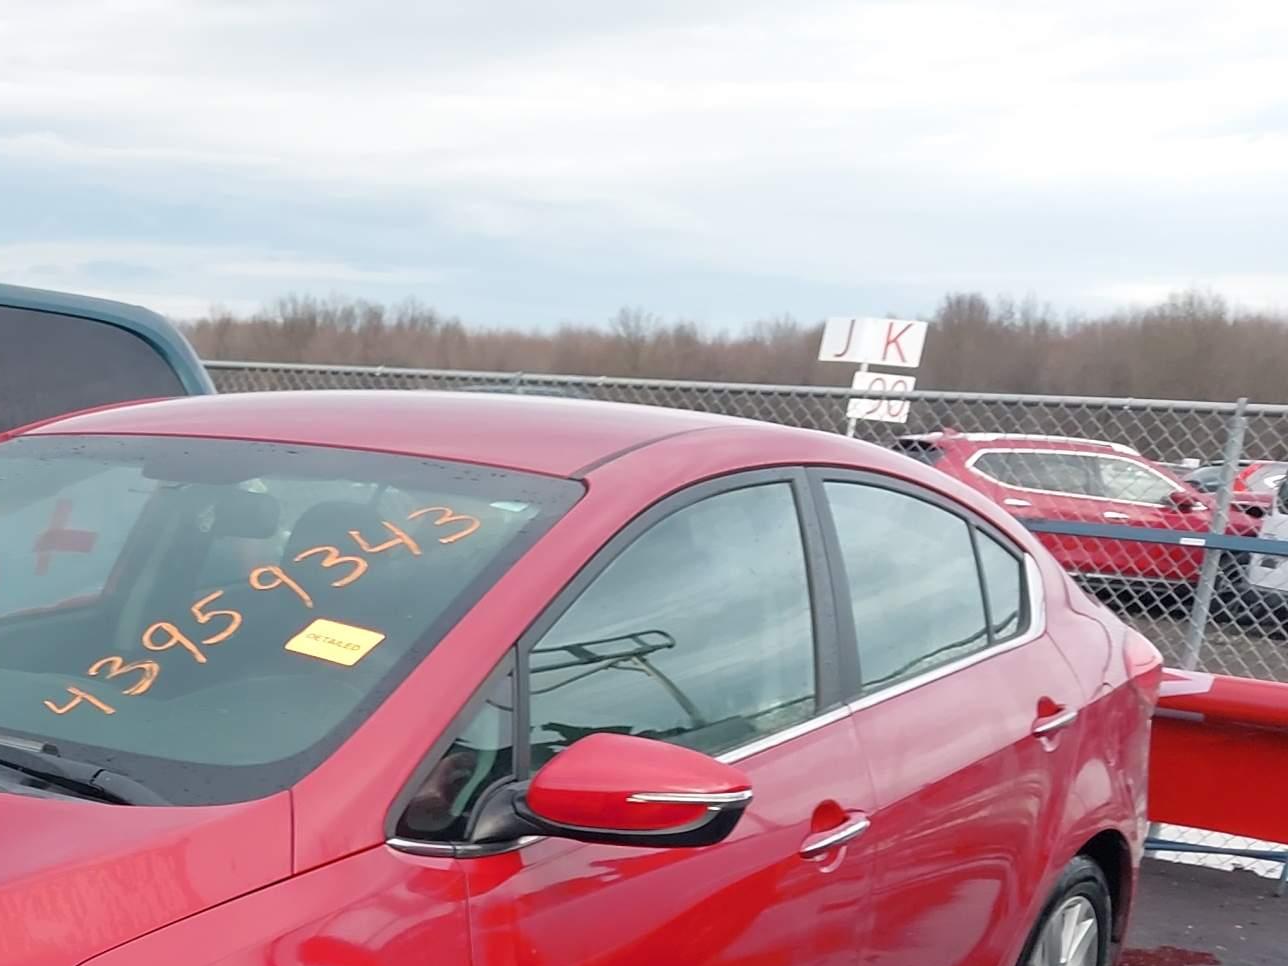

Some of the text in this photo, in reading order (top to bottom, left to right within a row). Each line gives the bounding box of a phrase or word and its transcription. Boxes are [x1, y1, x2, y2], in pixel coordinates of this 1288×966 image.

[833, 319, 915, 363] J K
[44, 506, 481, 714] 43959343
